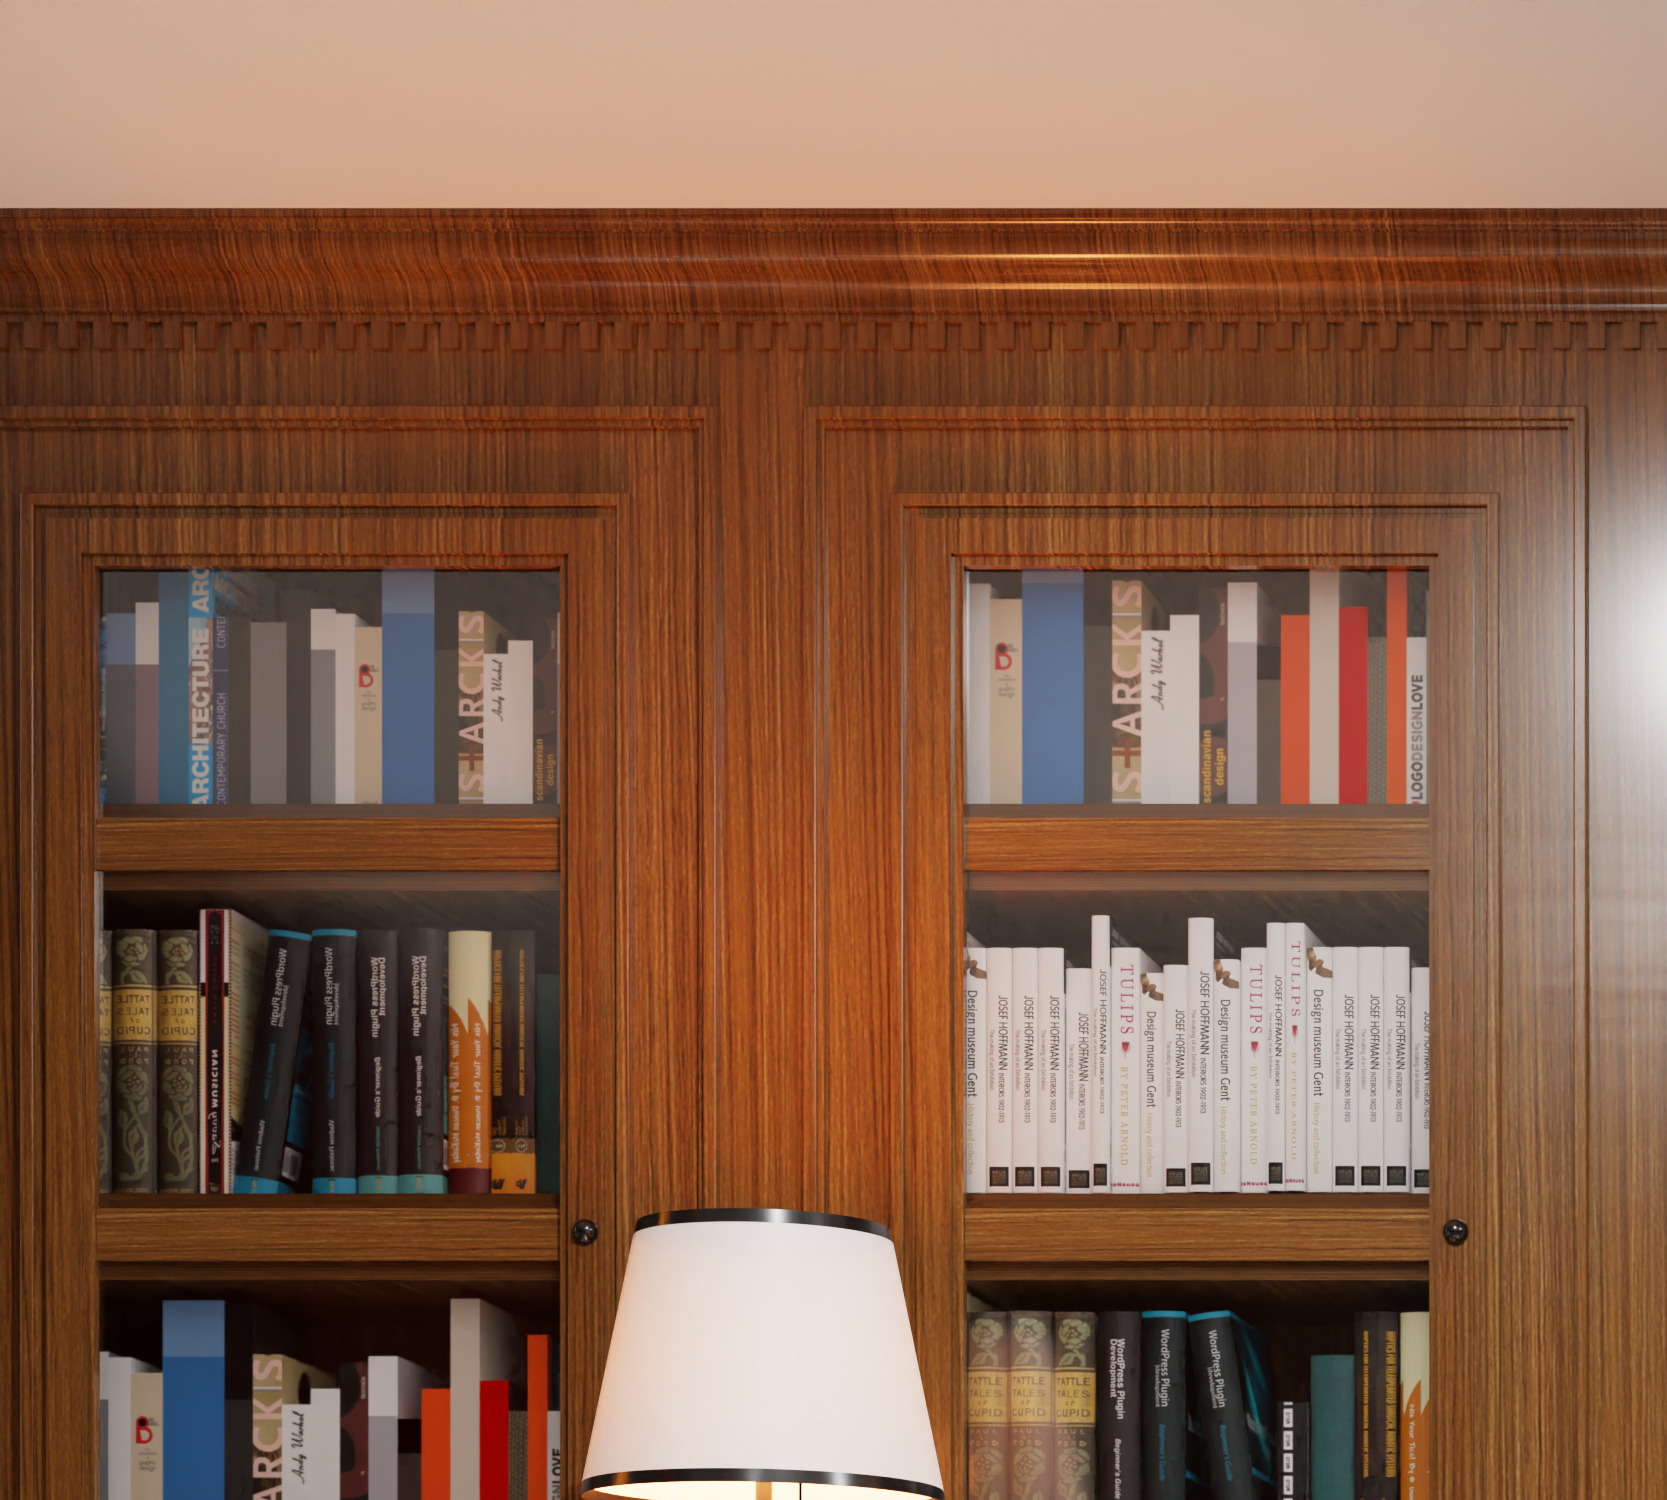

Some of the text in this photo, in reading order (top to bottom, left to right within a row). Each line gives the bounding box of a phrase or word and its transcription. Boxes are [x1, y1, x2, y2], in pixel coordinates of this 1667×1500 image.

[1219, 601, 1227, 625] TASCHEN
[492, 659, 504, 721] Andy Warhol
[1151, 637, 1166, 710] Andy Warhol
[190, 626, 210, 804] ARCHITECTURE
[534, 737, 546, 803] scandinavian
[547, 752, 557, 788] design
[1202, 729, 1213, 805] scandinavian
[1215, 747, 1227, 788] design
[1121, 965, 1134, 1034] TULIPS
[1200, 971, 1210, 998] JOSEF
[1200, 1001, 1210, 1054] HOFFMANN
[1219, 1000, 1231, 1100] Design museum Gent
[1120, 1067, 1128, 1166] BY PETER ARNOLD
[1219, 1105, 1227, 1128] History
[1056, 1389, 1091, 1399] TALES
[1057, 1376, 1090, 1387] TATTLE
[1108, 1337, 1119, 1399] Development
[1116, 1337, 1126, 1421] WordPress Plugin
[1056, 1407, 1090, 1419] CUPID
[292, 1411, 306, 1483] Andy Warhol
[1113, 1437, 1122, 1500] Beginner's Guide
